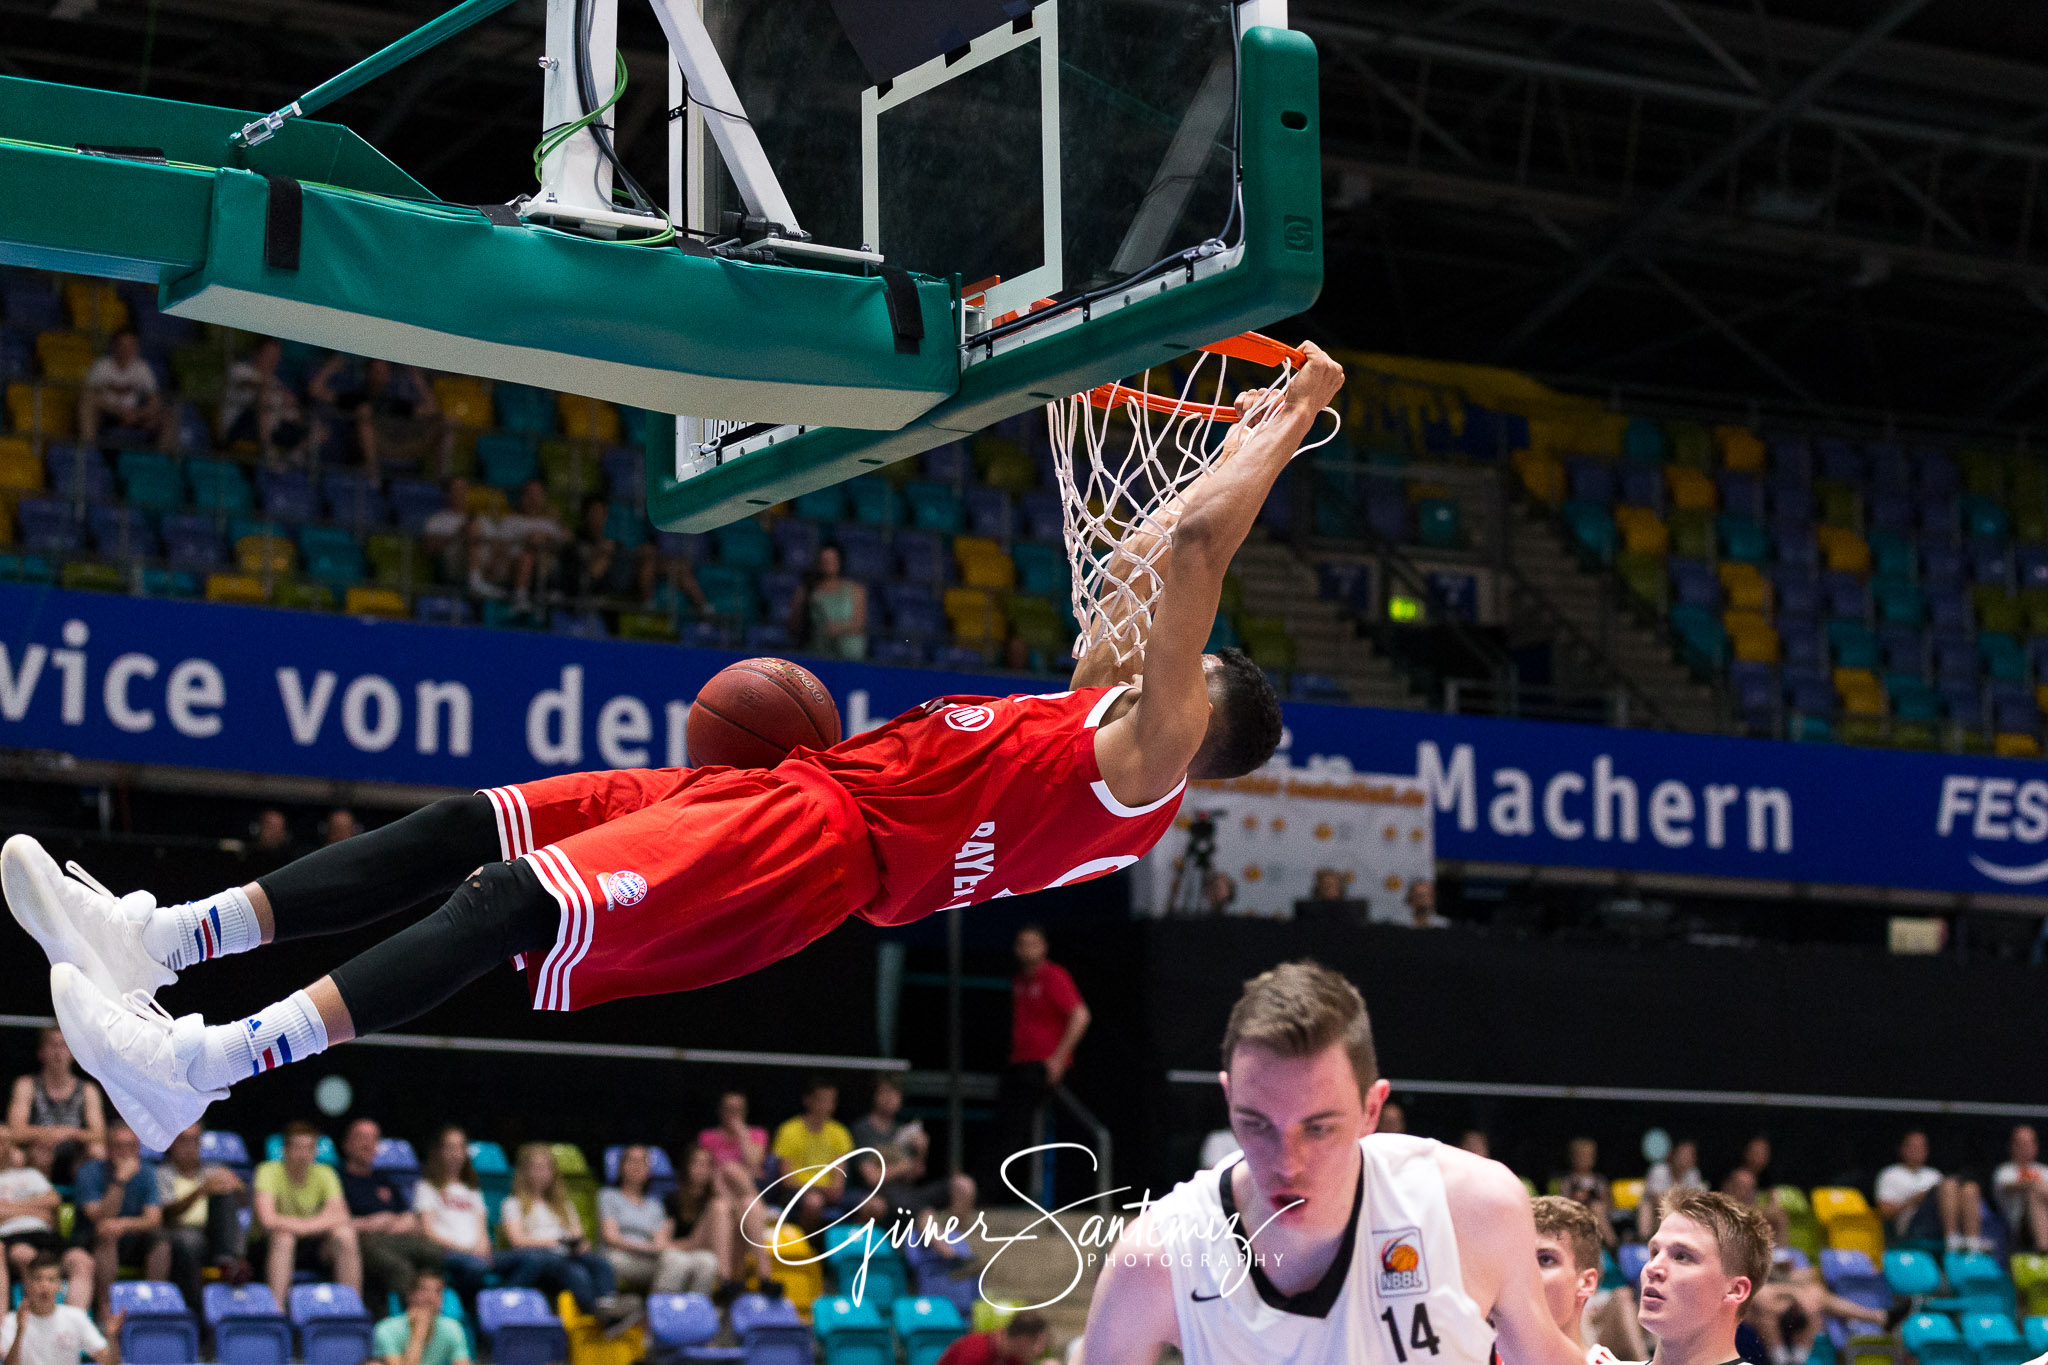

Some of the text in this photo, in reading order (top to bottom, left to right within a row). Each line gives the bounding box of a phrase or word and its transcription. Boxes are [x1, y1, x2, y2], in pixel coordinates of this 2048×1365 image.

[0, 619, 226, 738] vice
[276, 667, 472, 757] von
[1415, 740, 1793, 854] Machern
[1381, 1270, 1423, 1290] NBBL
[1381, 1303, 1440, 1363] 14
